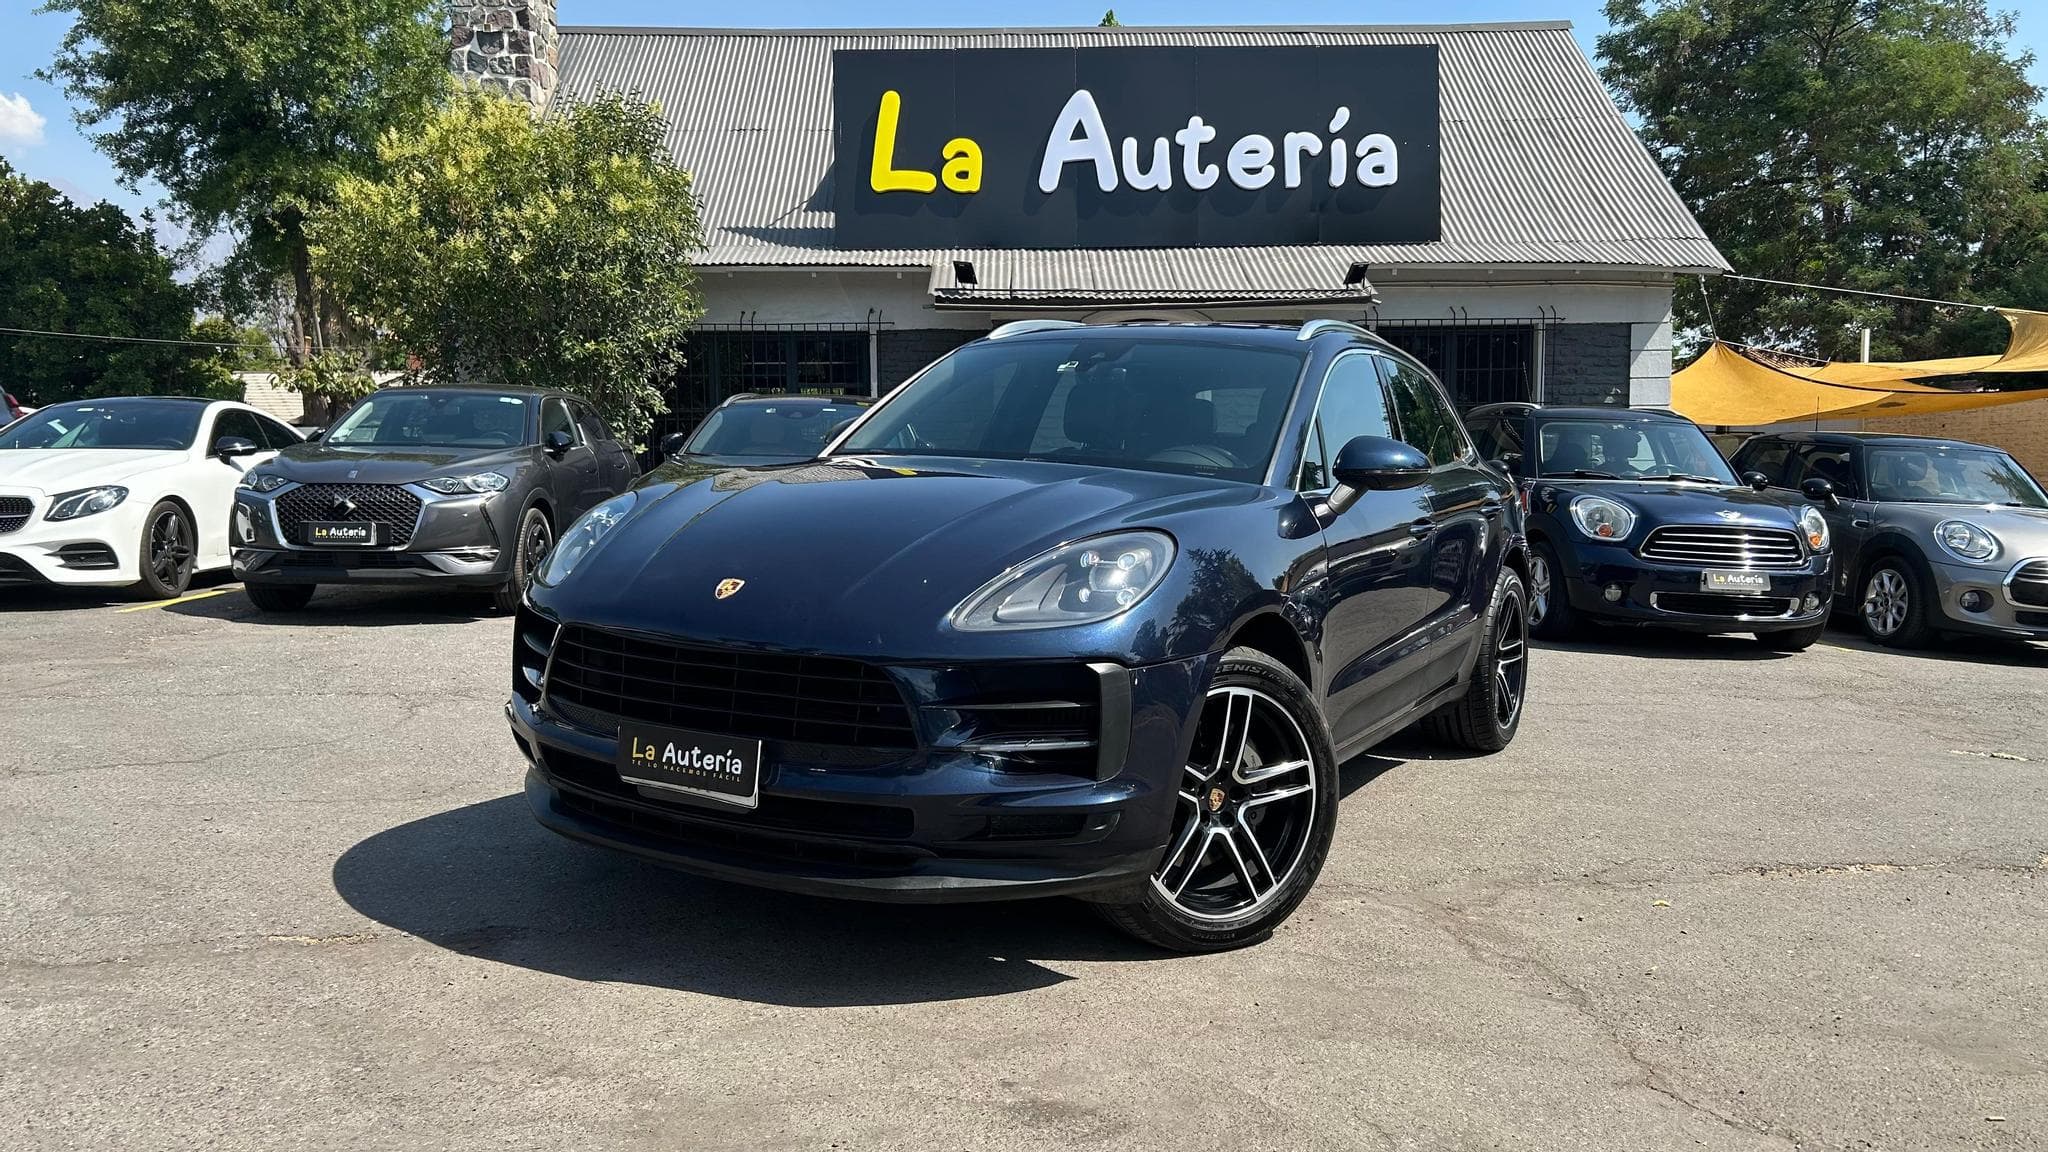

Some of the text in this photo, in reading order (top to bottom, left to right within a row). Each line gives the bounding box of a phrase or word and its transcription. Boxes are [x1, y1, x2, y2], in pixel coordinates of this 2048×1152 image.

[871, 89, 1399, 193] La Autería
[315, 527, 327, 536] La
[1713, 574, 1725, 582] La
[632, 737, 742, 774] La Autería
[664, 765, 706, 777] HACEMOS
